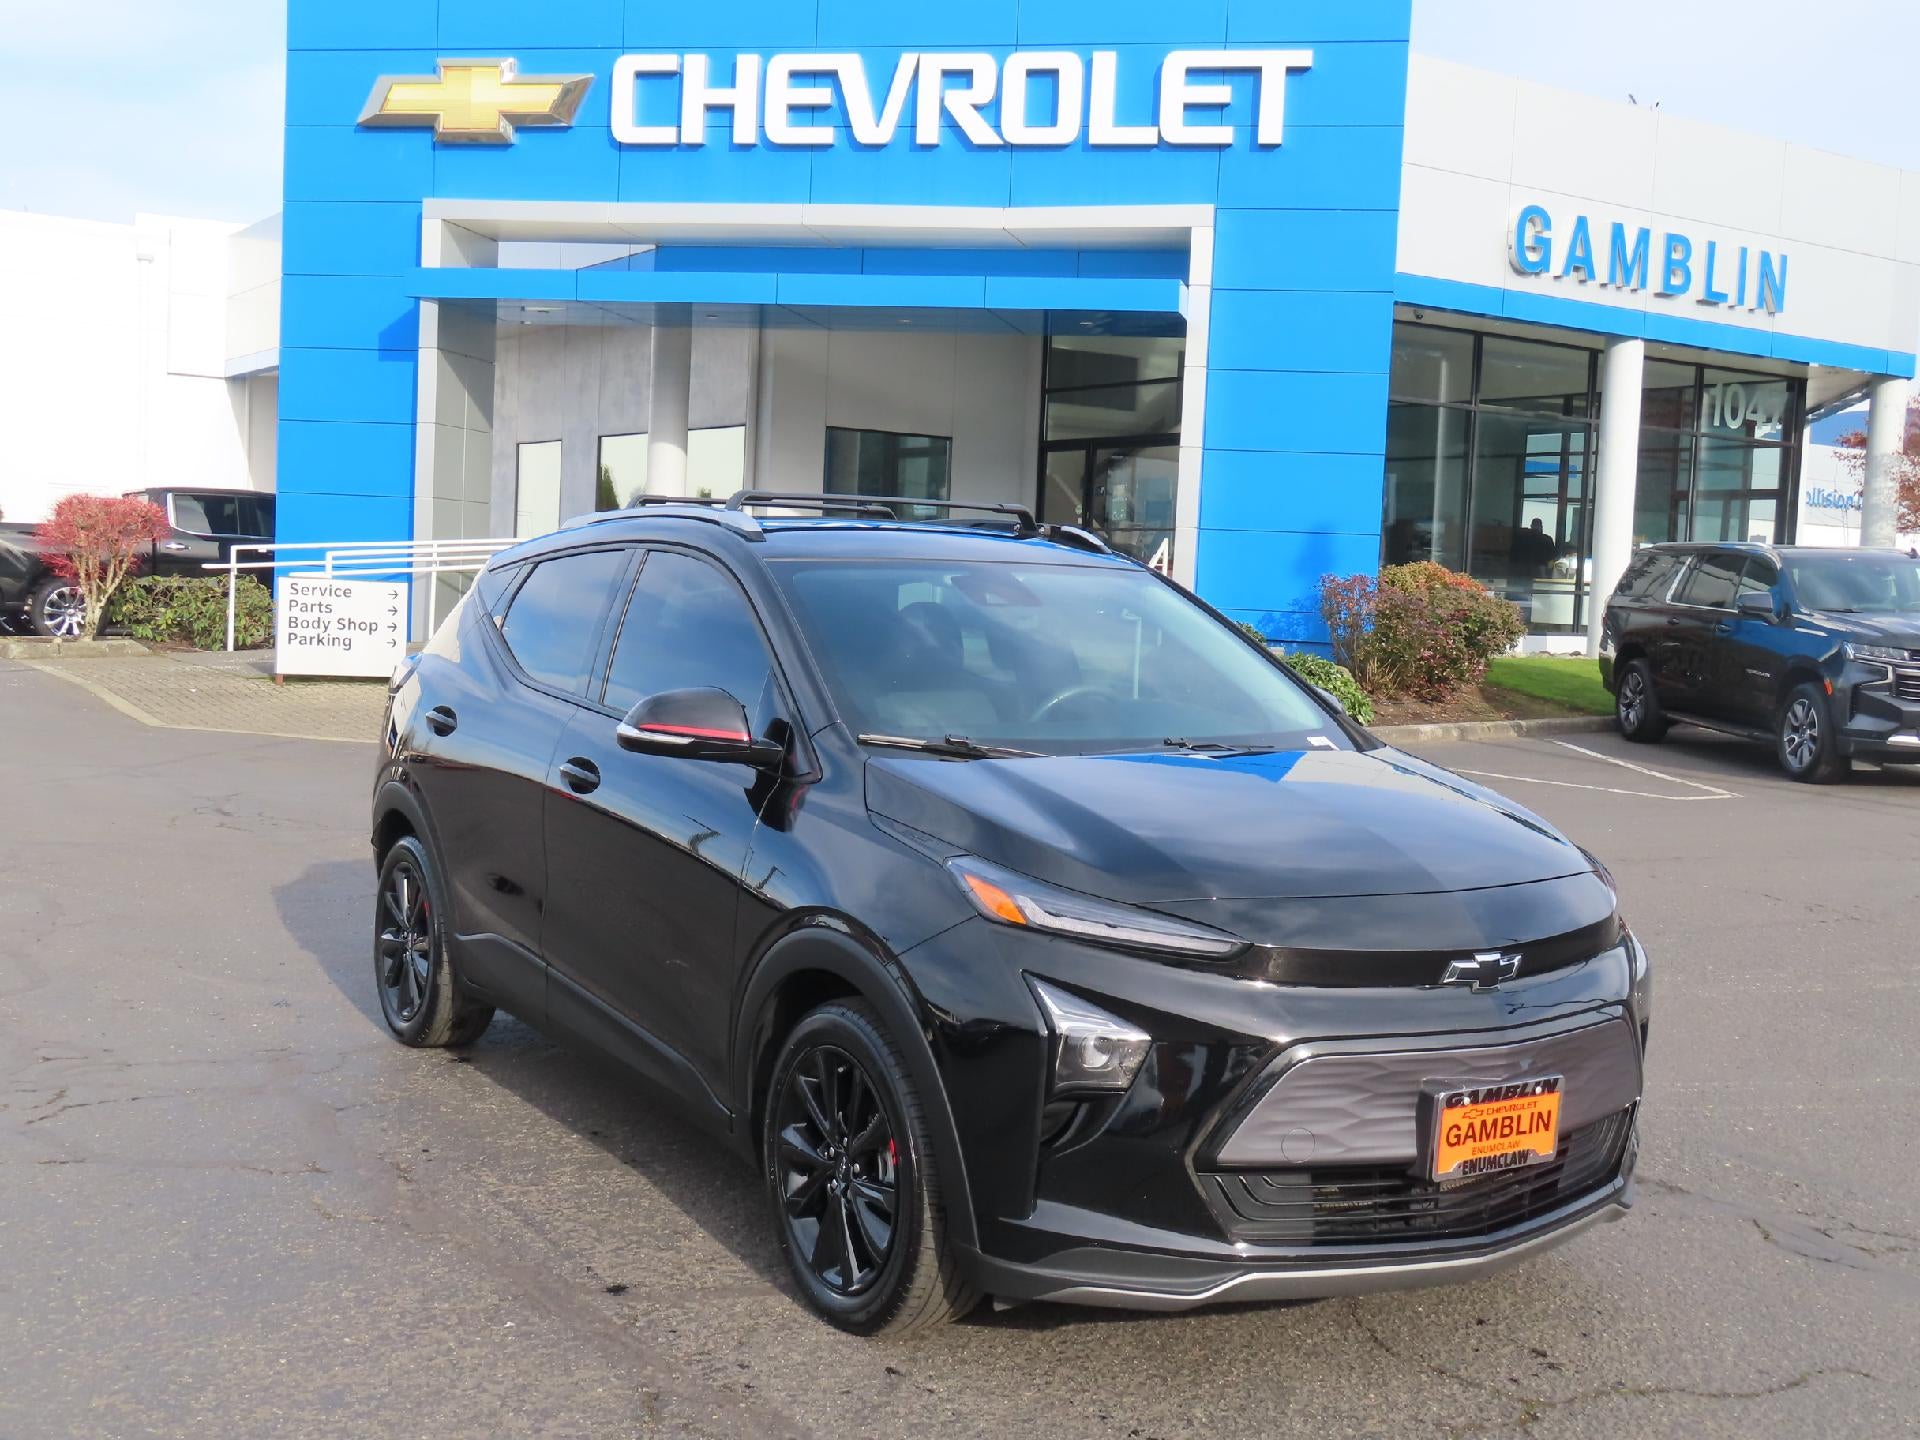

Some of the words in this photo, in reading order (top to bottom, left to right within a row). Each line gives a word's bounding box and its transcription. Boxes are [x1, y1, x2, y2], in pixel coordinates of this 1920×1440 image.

[610, 50, 1314, 146] CHEVROLET
[1511, 205, 1788, 314] GAMBLIN
[290, 582, 352, 598] Service
[289, 599, 333, 614] Parts
[288, 616, 331, 632] Body
[337, 617, 378, 635] Shop
[287, 632, 352, 651] Parking
[1445, 1078, 1559, 1109] GAMBLIN
[1486, 1101, 1539, 1116] CHEVROLET
[1445, 1109, 1552, 1147] GAMBLIN
[1471, 1140, 1522, 1156] ENUMCLAW
[1461, 1148, 1530, 1176] ENUMCLAW
